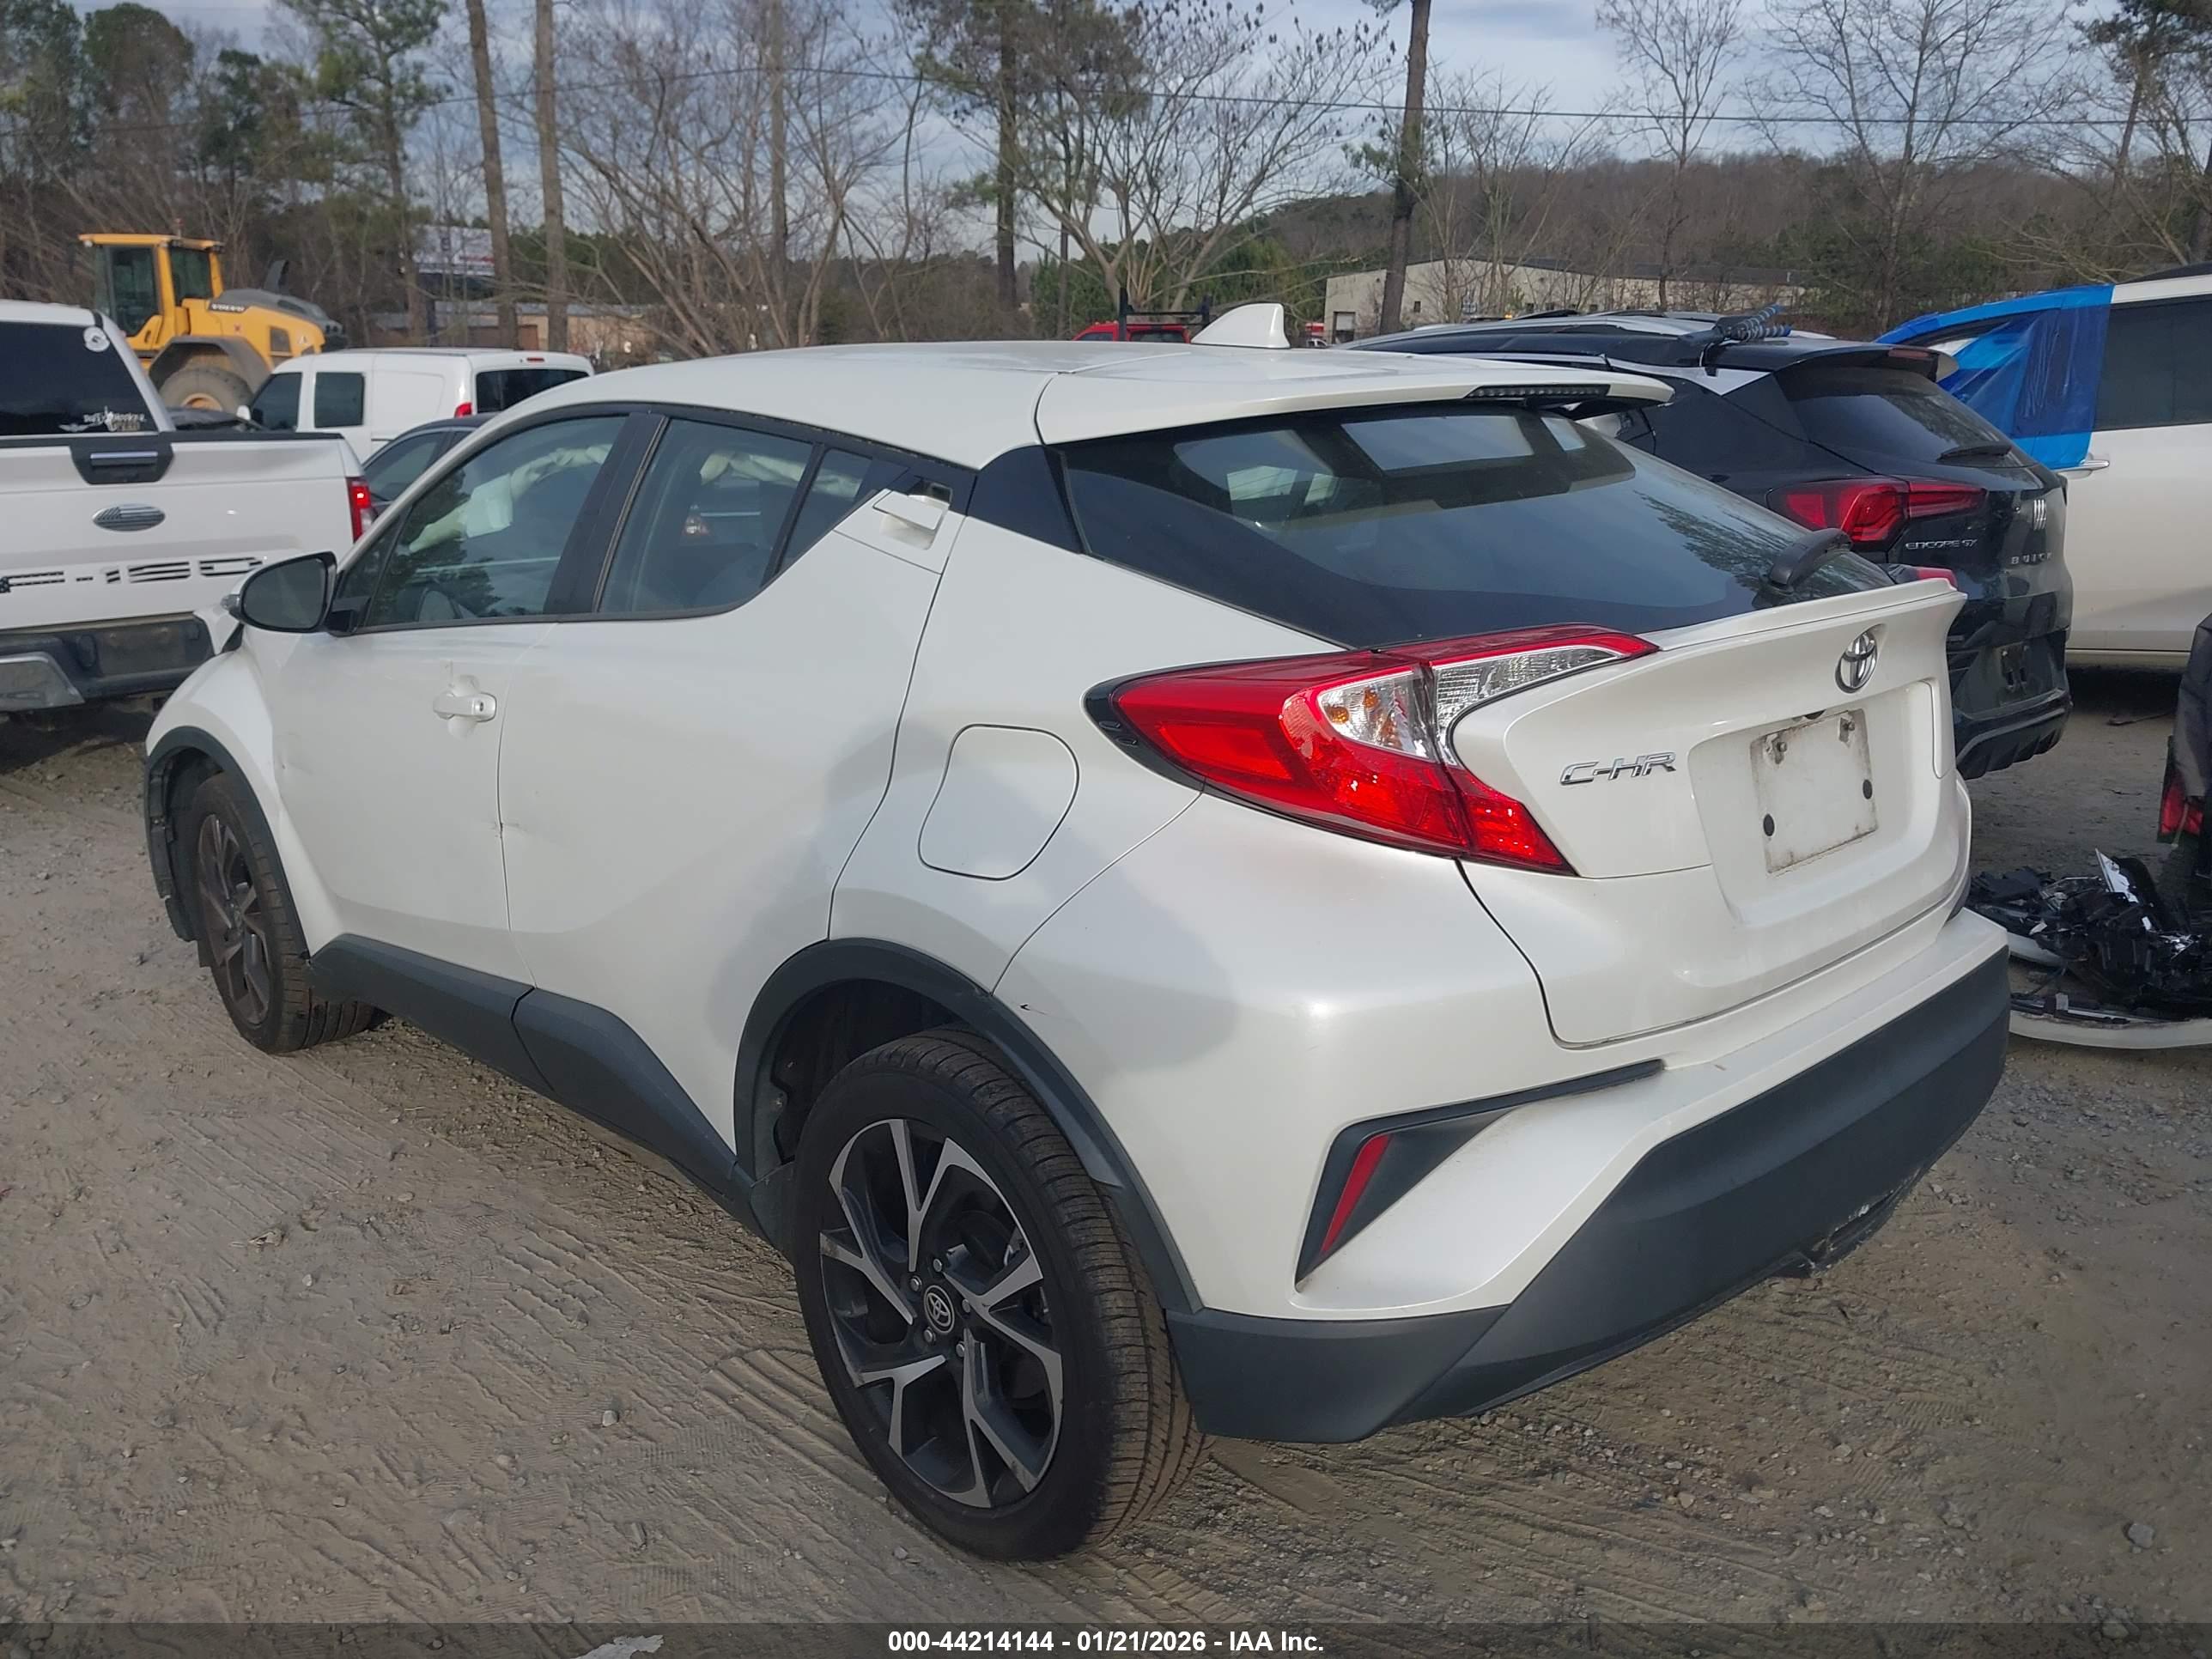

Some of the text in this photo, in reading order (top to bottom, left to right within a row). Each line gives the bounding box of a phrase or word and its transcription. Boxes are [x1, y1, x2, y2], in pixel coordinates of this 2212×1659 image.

[1905, 539, 1960, 550] ENCORE
[2010, 551, 2054, 565] BUICK
[1559, 750, 1677, 786] C-HR
